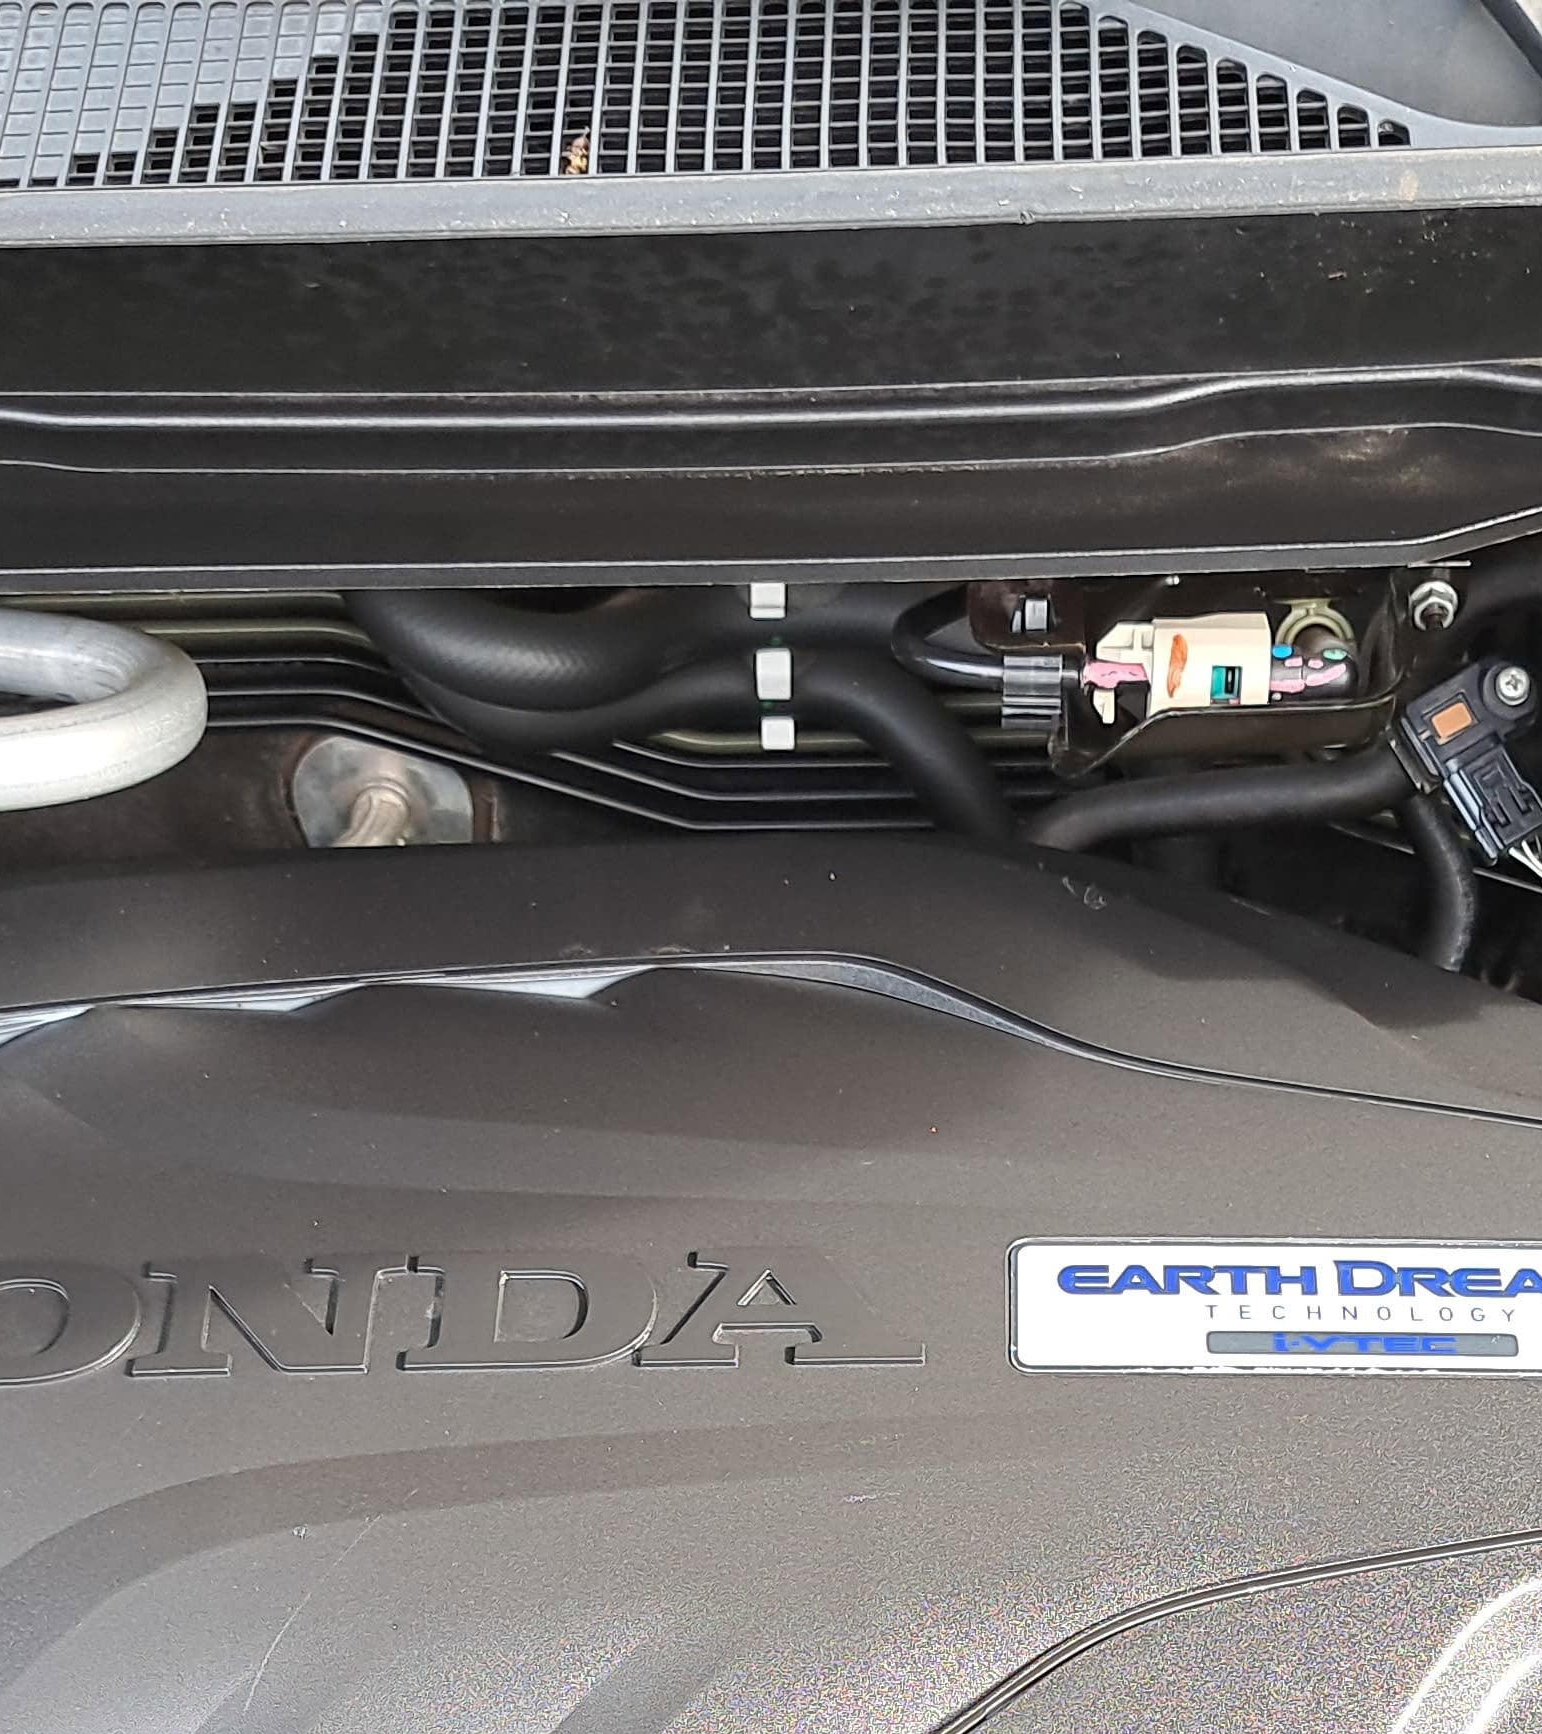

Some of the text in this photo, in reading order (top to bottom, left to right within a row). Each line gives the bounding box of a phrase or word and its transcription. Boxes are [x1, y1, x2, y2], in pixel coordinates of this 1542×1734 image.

[1057, 1262, 1317, 1297] EARTH
[1204, 1303, 1518, 1324] TECHNOLOGY
[1271, 1331, 1459, 1355] i-VTEC
